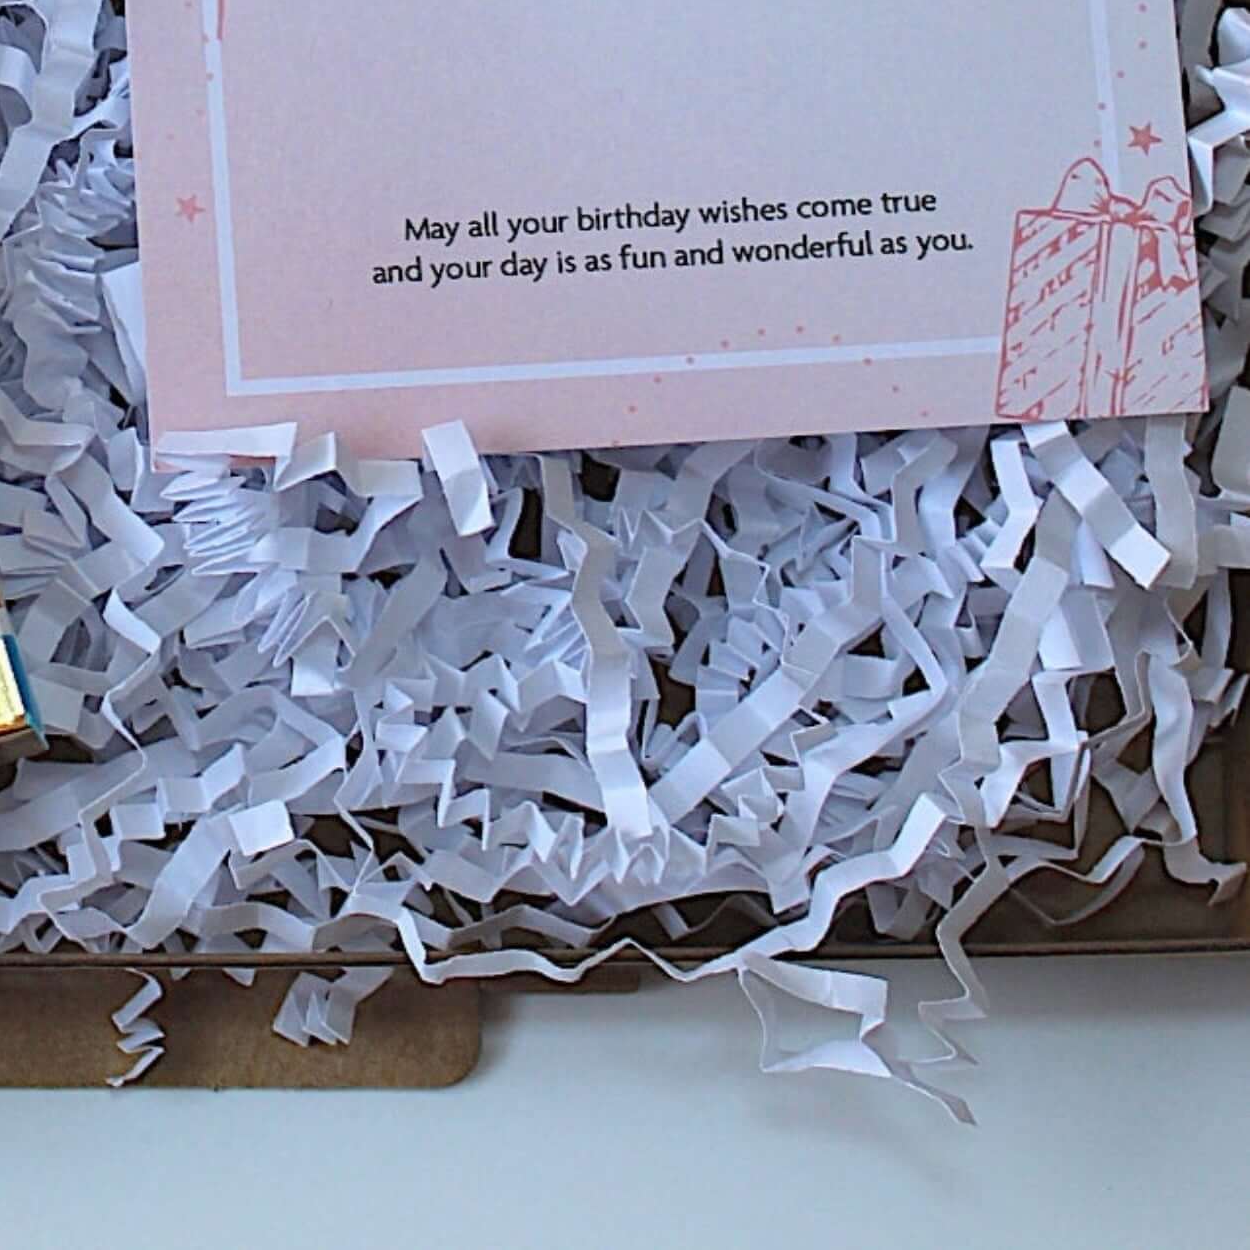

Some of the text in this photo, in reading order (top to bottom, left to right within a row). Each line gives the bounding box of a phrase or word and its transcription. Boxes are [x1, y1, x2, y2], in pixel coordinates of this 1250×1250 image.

[404, 192, 937, 247] May all your birthday wishes come true
[372, 229, 974, 288] and your day is as fun and wonderful as you.
